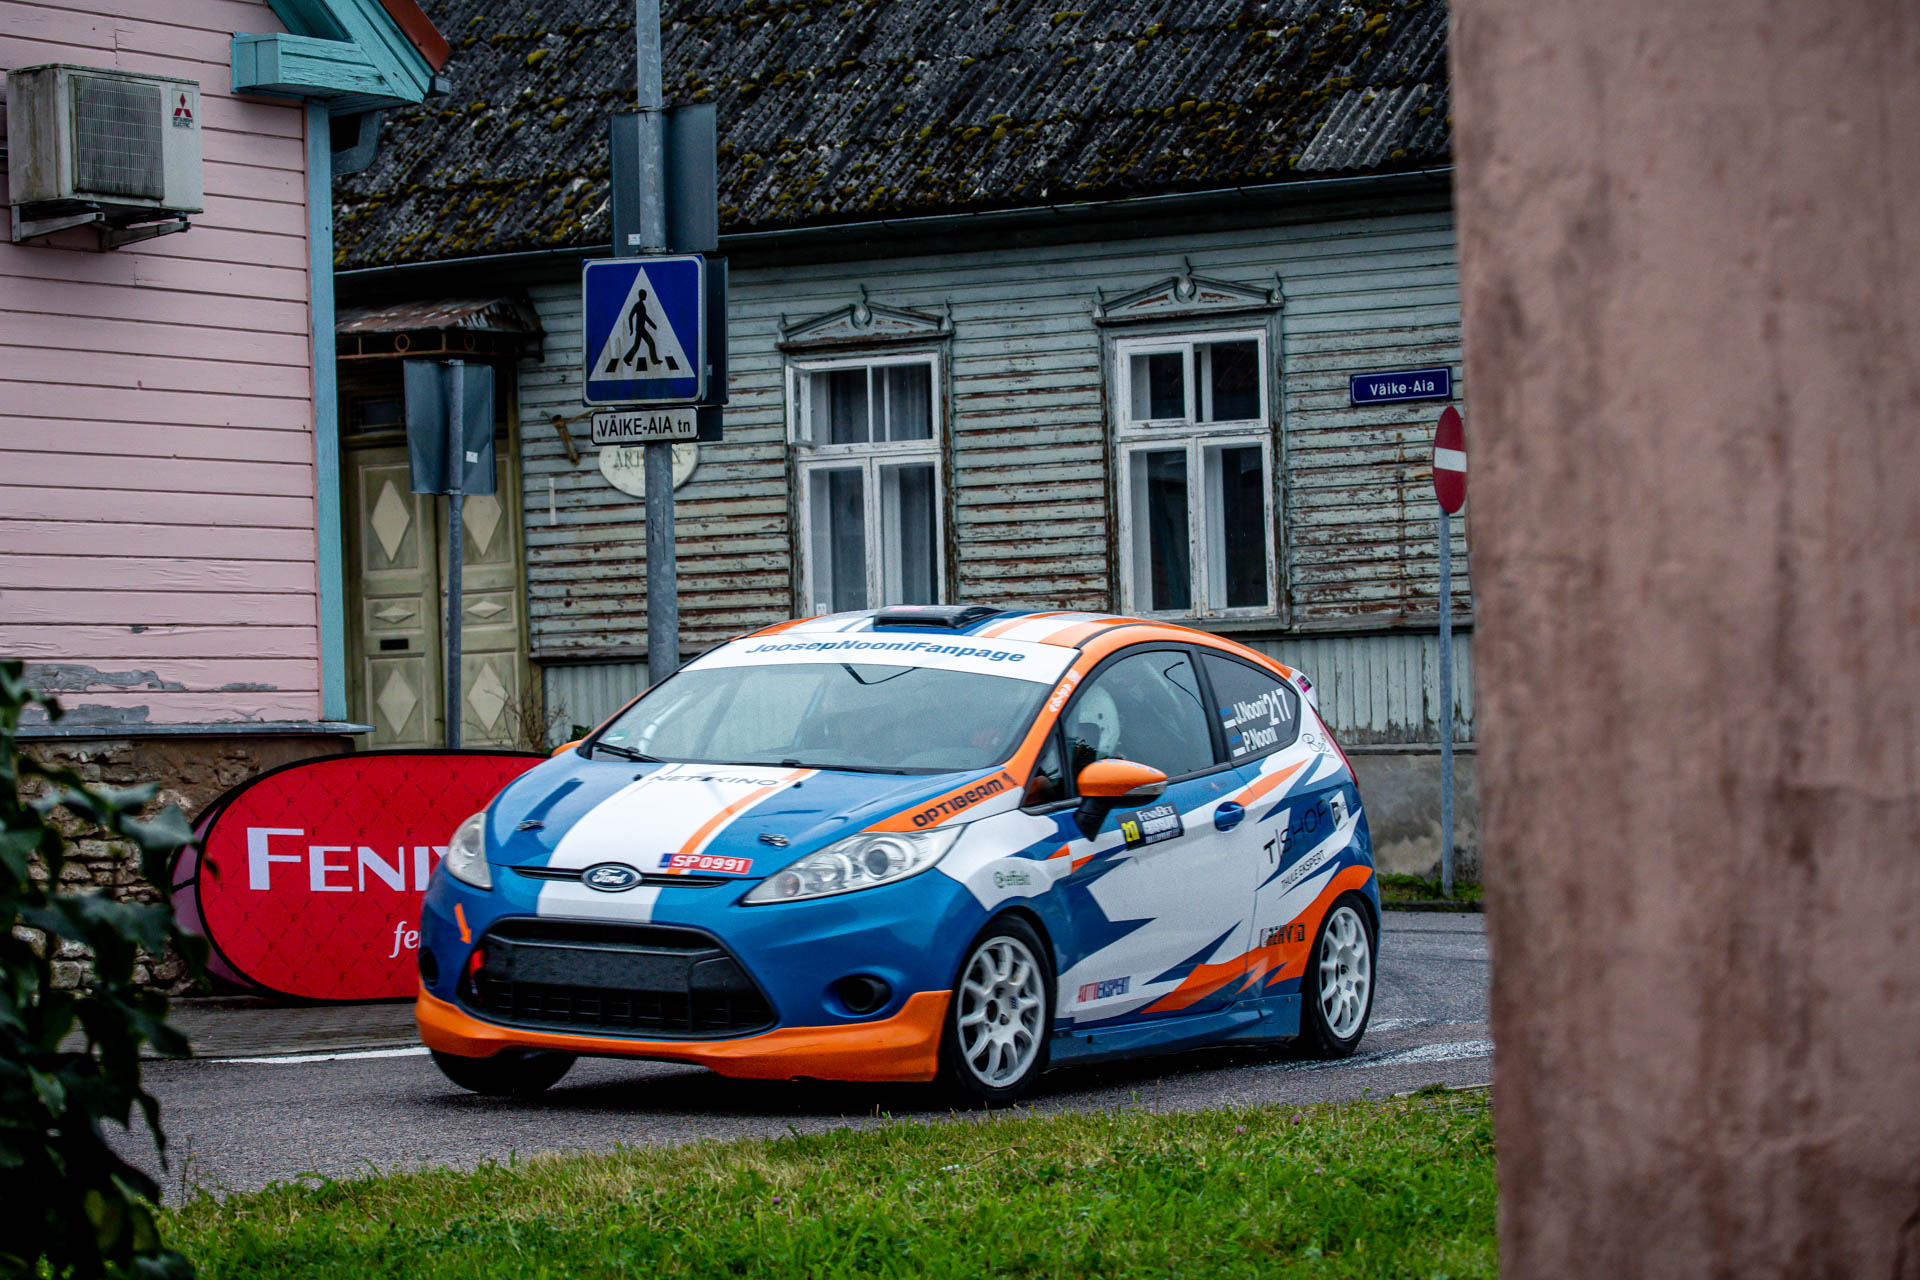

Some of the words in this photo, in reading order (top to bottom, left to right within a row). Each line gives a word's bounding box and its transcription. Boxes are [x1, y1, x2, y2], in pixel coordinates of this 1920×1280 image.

[1370, 380, 1435, 396] Väike-Aia
[599, 415, 673, 438] VÄIKE-AIA
[677, 419, 691, 433] tn
[1263, 688, 1292, 726] 217
